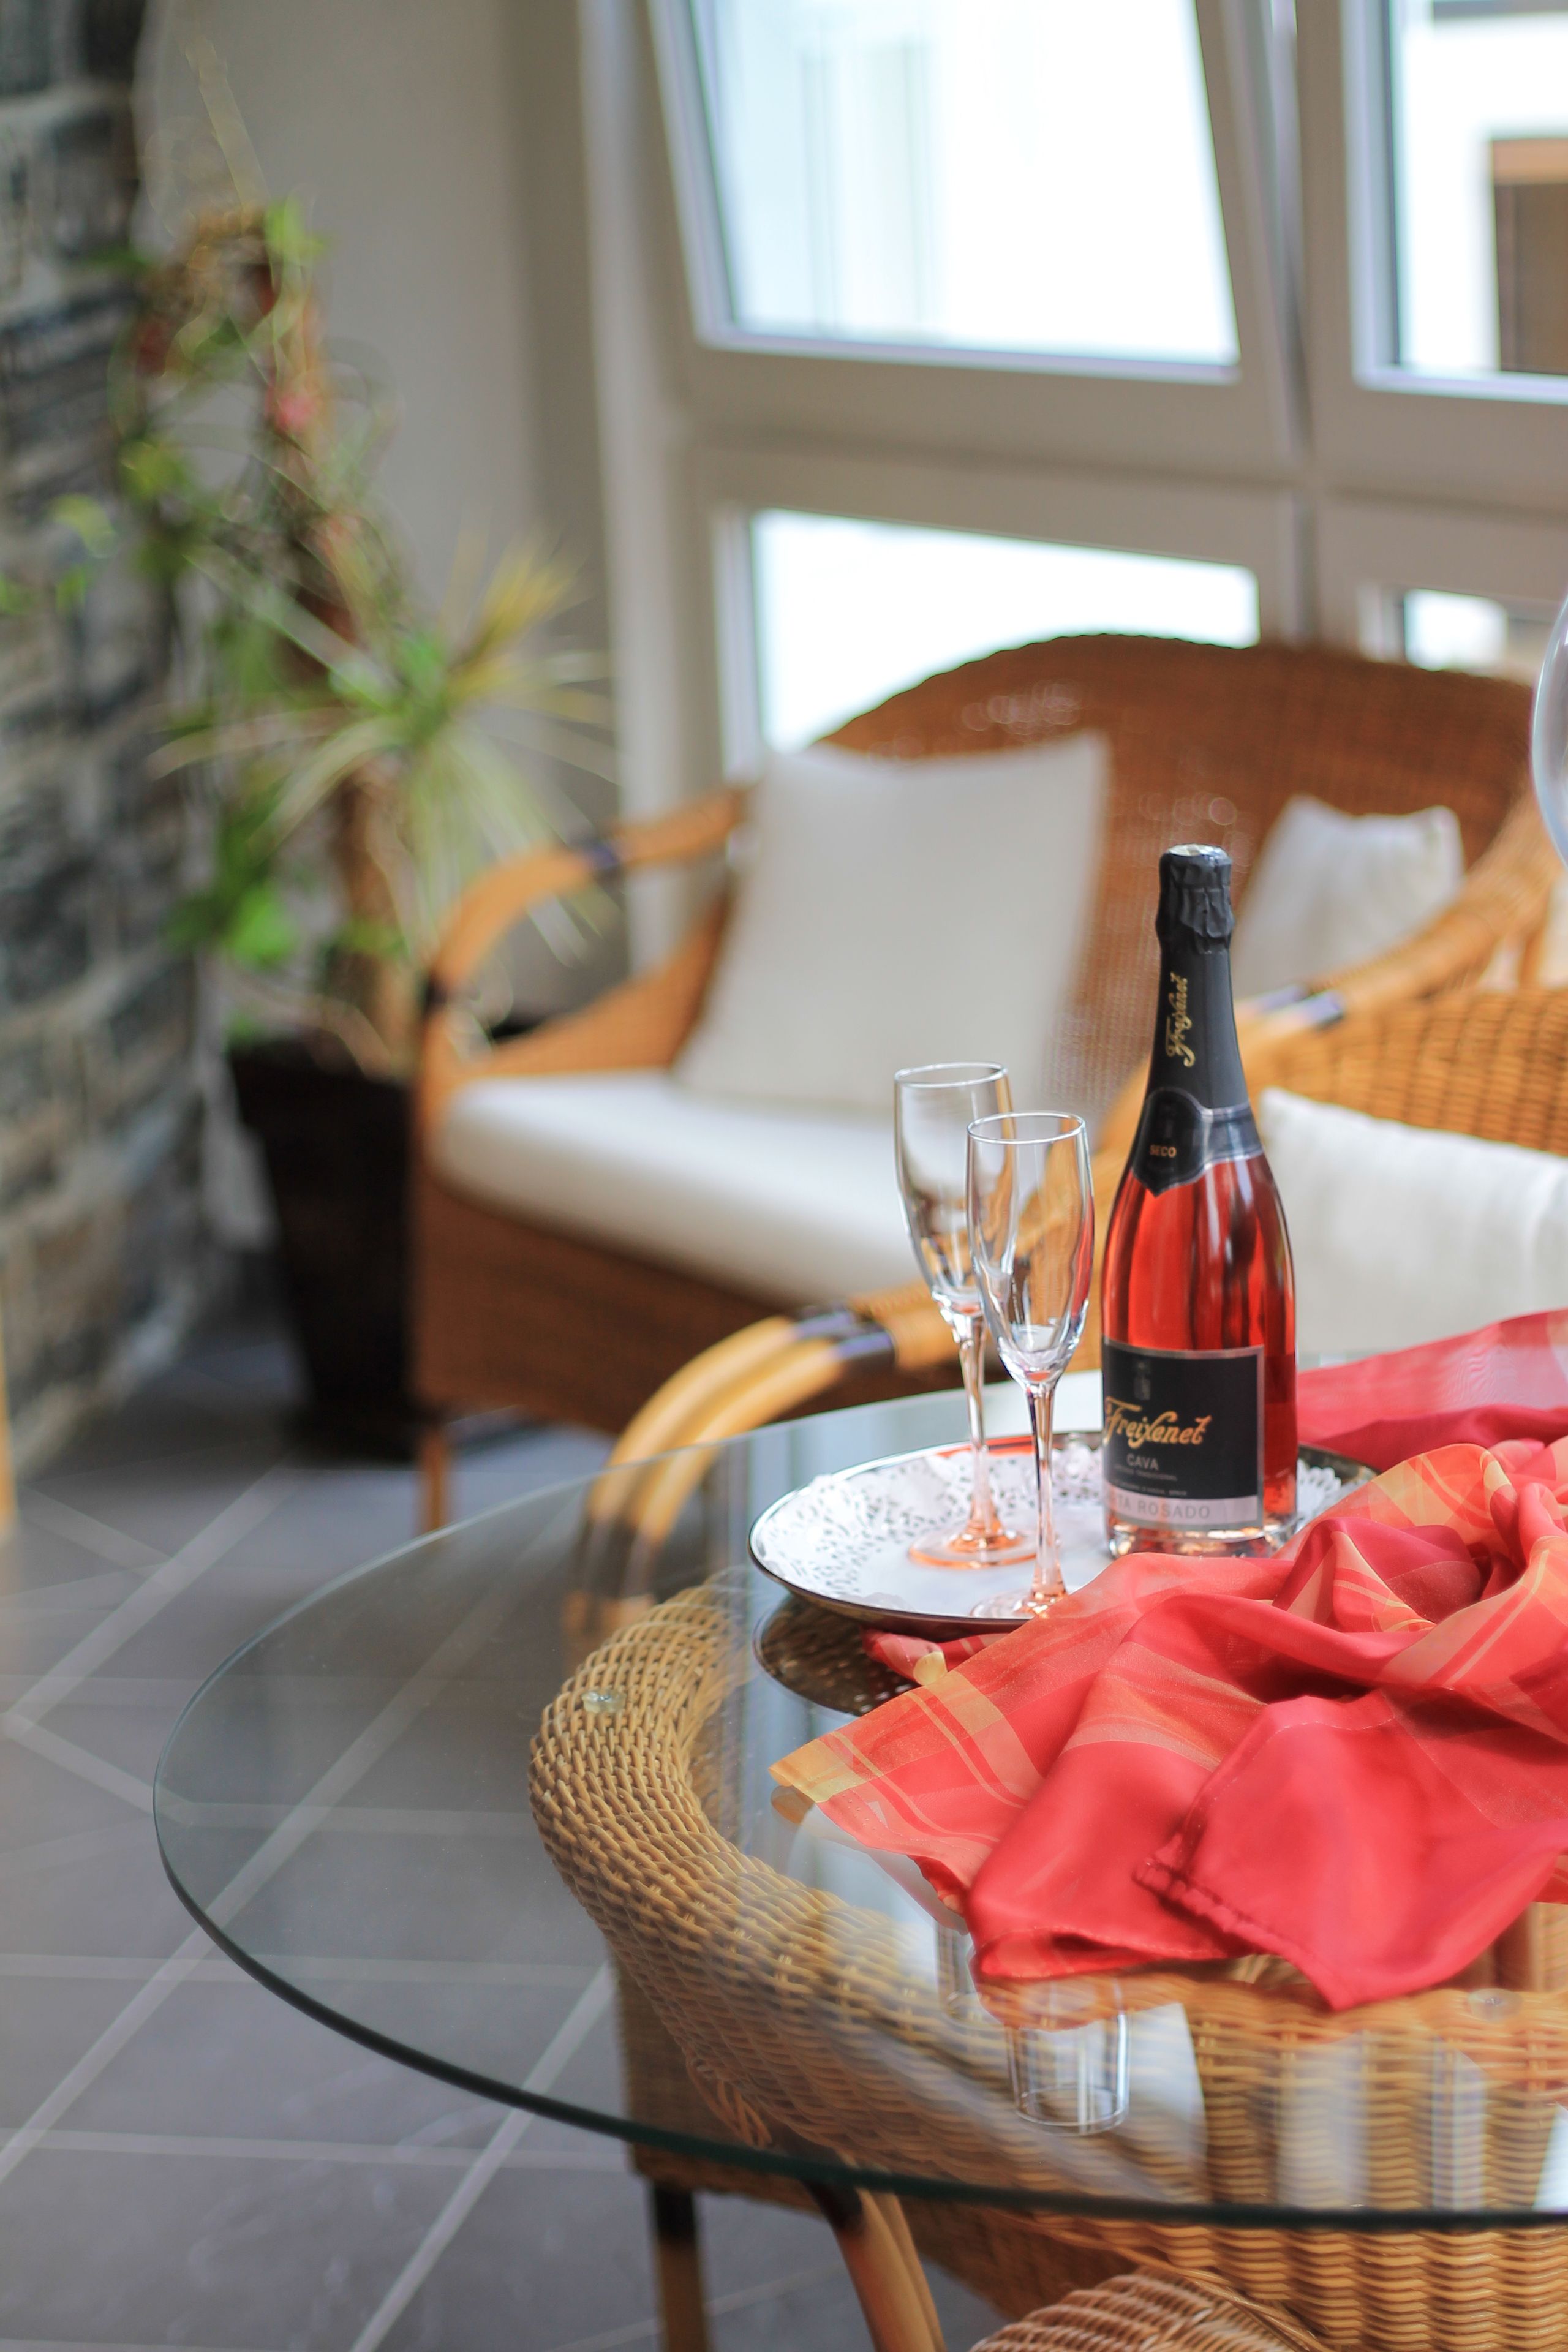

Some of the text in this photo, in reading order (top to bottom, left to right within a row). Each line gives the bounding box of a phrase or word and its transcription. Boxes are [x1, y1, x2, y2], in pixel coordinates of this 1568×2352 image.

[1150, 1144, 1177, 1158] SECO
[1104, 1396, 1212, 1447] Freixenet
[1127, 1453, 1159, 1470] CAVA
[1138, 1500, 1210, 1519] ROSADO
